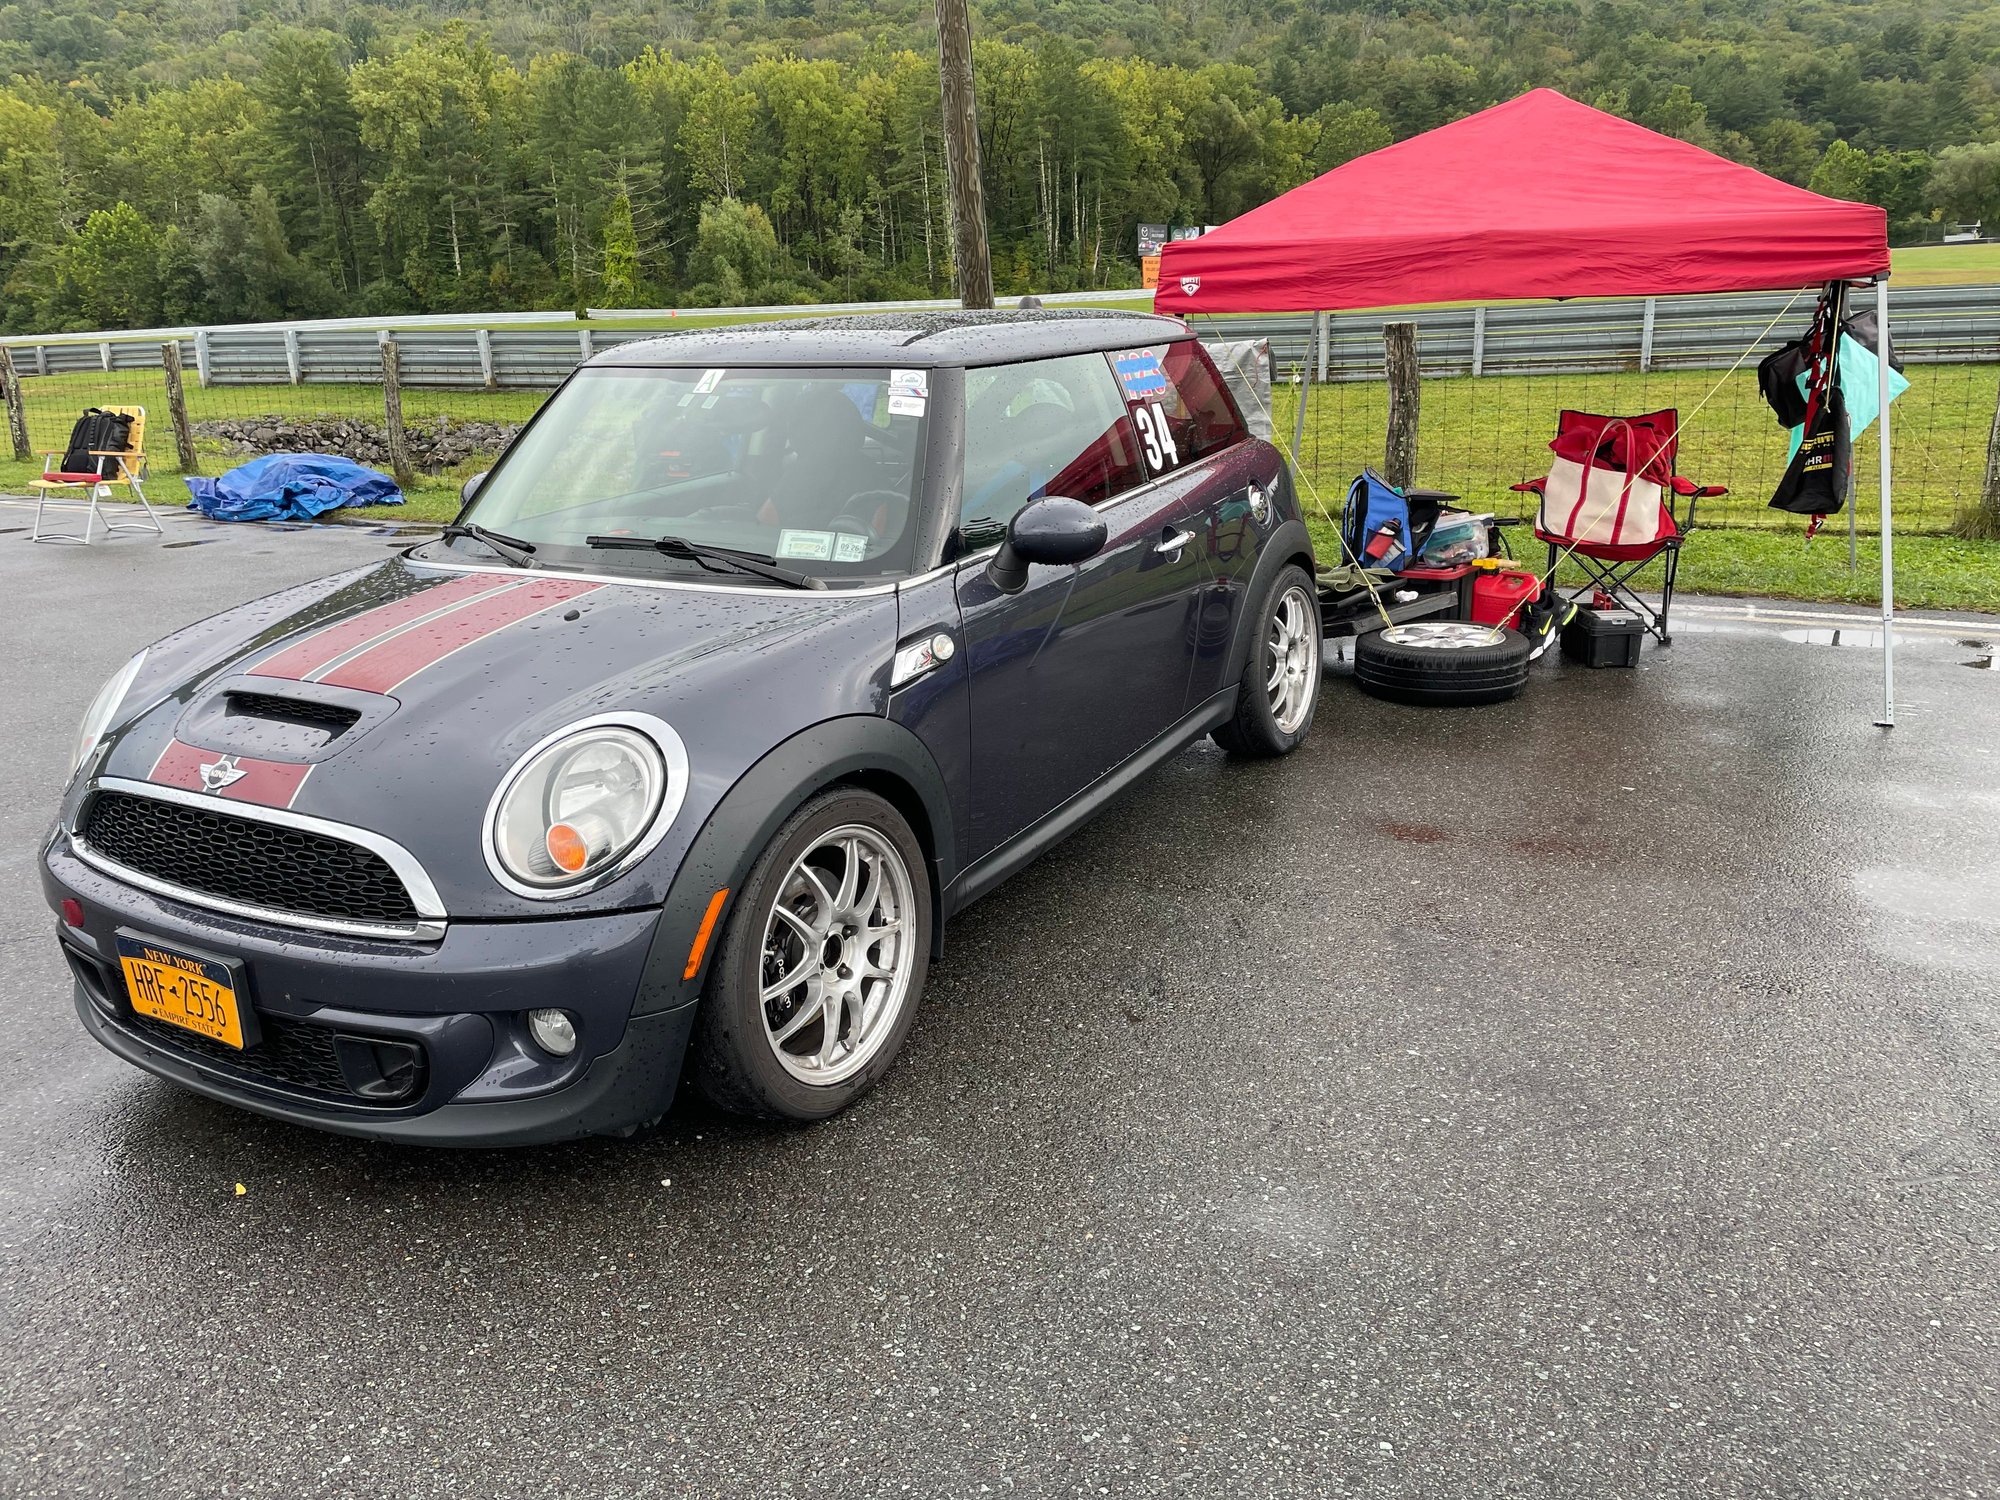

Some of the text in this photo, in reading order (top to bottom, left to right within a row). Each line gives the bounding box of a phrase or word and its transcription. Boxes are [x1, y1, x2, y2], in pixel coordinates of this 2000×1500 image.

[695, 370, 717, 392] A
[1135, 402, 1179, 471] 34
[143, 947, 205, 976] NEW YORK
[130, 961, 226, 1027] HRF 2556
[158, 1008, 217, 1036] EMPIRE STATE
